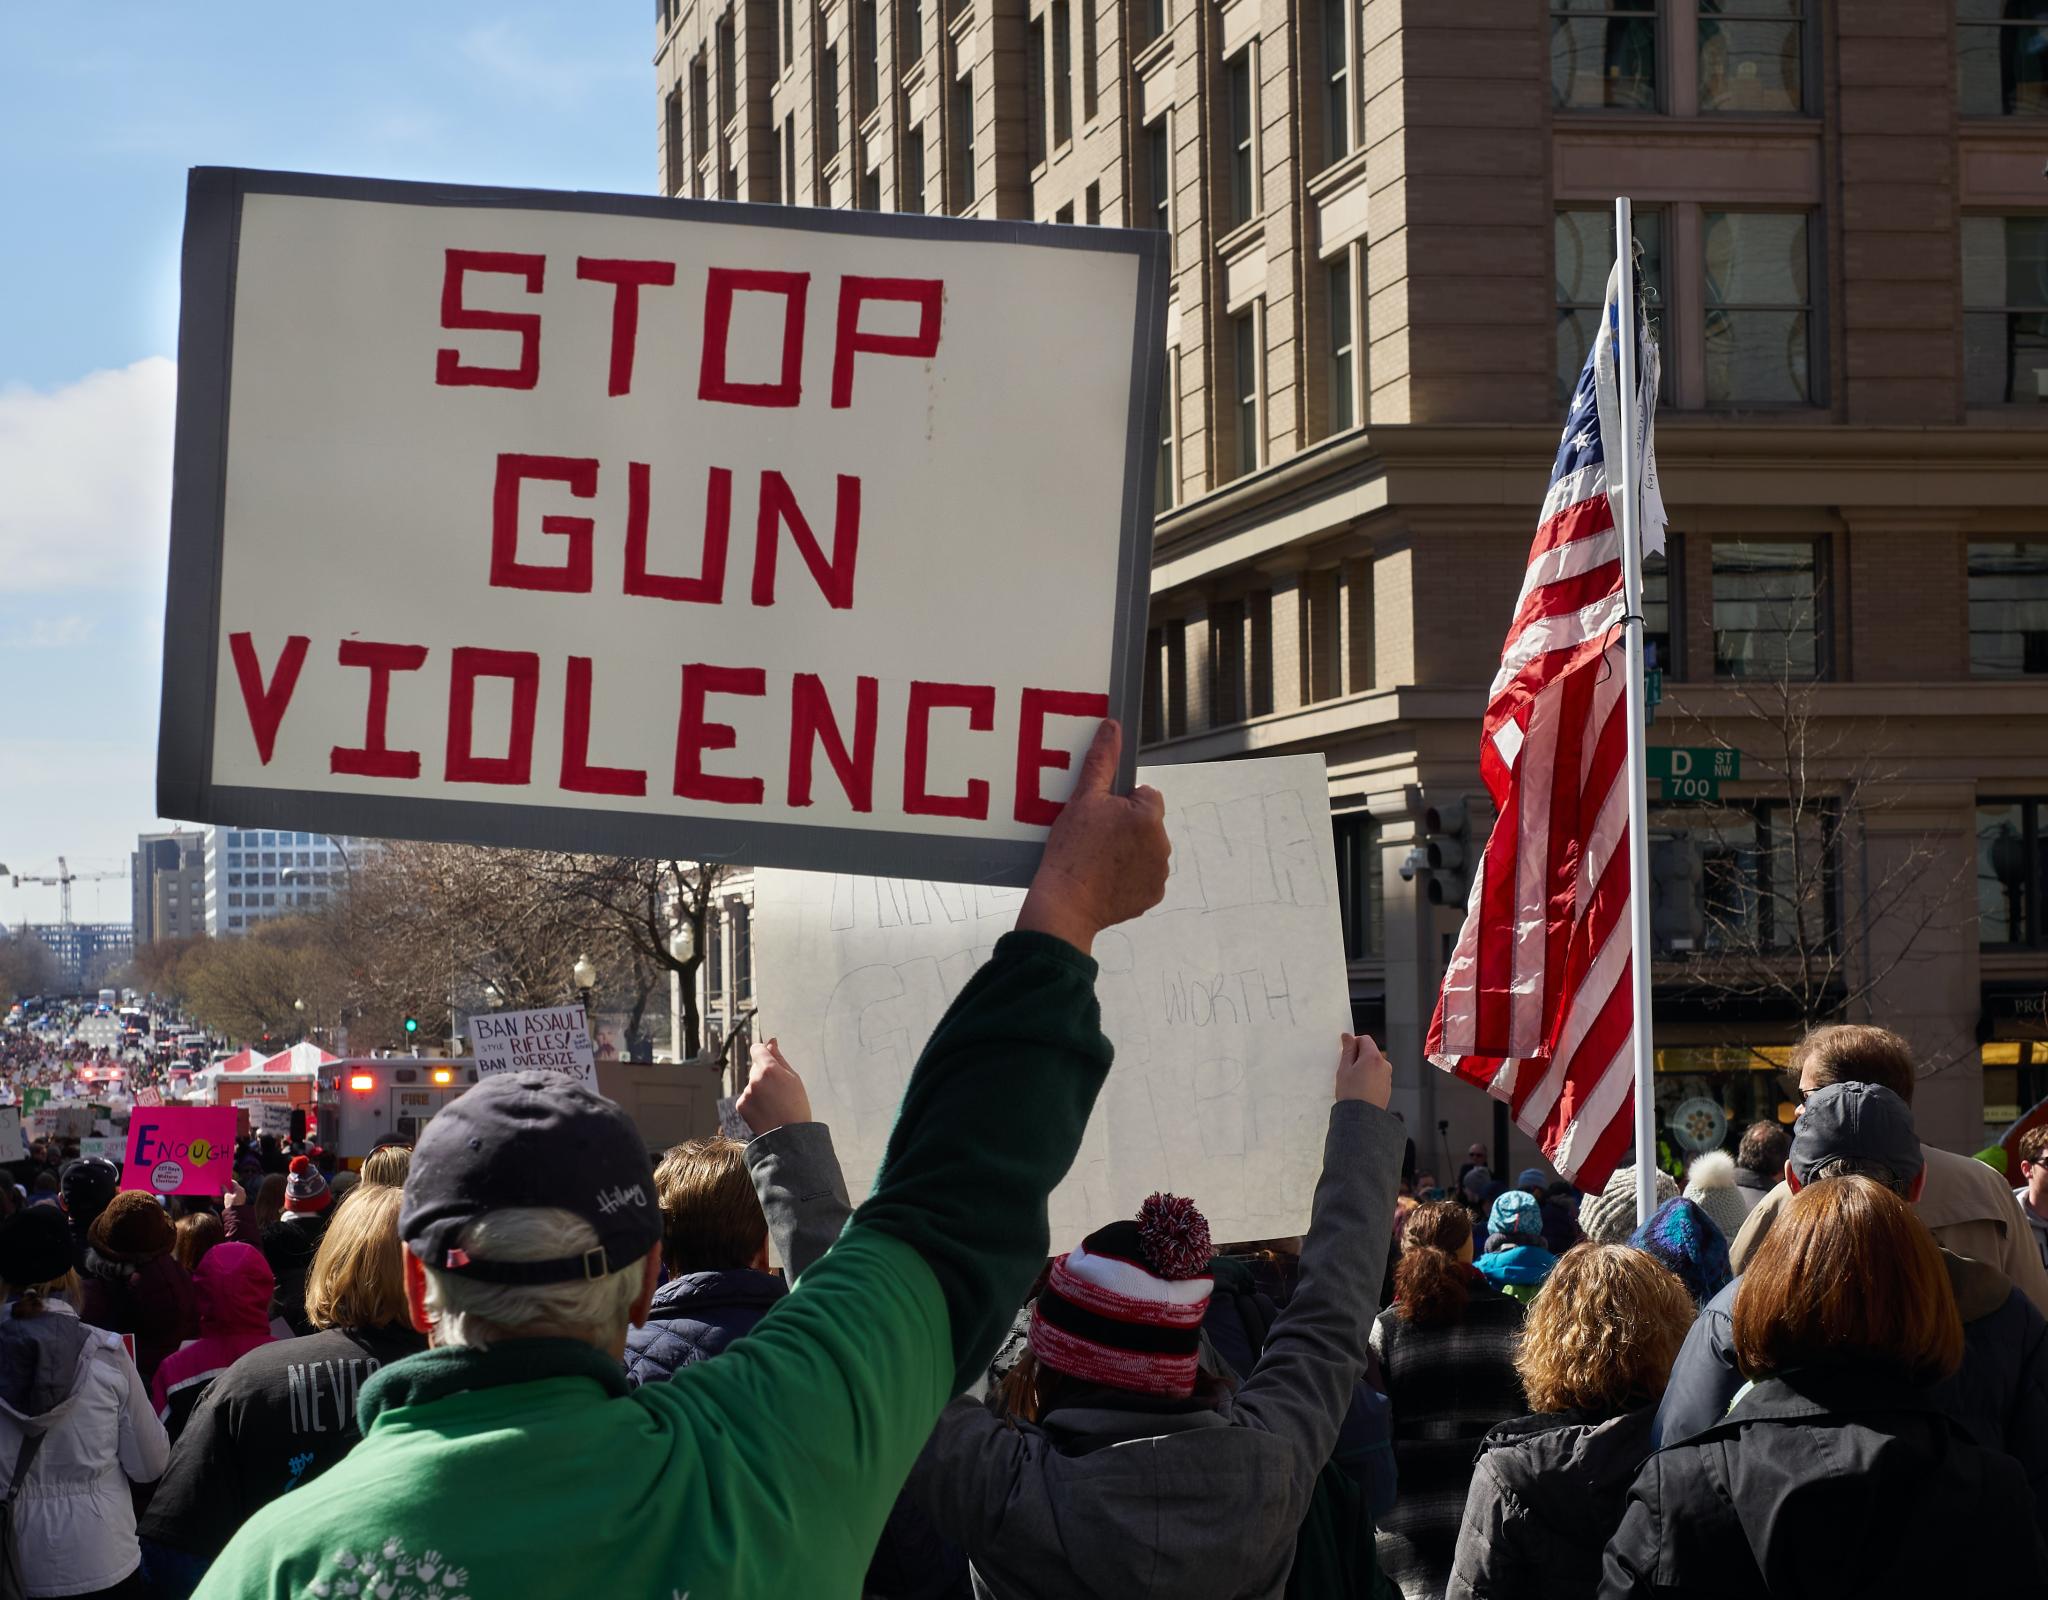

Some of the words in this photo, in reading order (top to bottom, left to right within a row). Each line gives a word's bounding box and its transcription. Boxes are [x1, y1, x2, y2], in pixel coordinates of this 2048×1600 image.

[436, 249, 944, 408] STOP
[490, 453, 861, 609] GUN
[230, 632, 1109, 826] VIOLENCE
[1671, 751, 1692, 776] D
[1715, 752, 1733, 764] ST
[1714, 765, 1732, 776] NW
[1671, 779, 1709, 796] 700
[1162, 960, 1296, 1027] WORTH
[475, 1017, 518, 1039] BAN
[525, 1009, 586, 1035] ASSAULT
[510, 1031, 571, 1055] RIFLES!
[479, 1058, 506, 1072] BAN
[513, 1052, 577, 1066] OVERSIZE
[245, 1087, 286, 1095] U-HAUL
[401, 1093, 430, 1105] FIRE
[287, 1357, 381, 1434] NEVE
